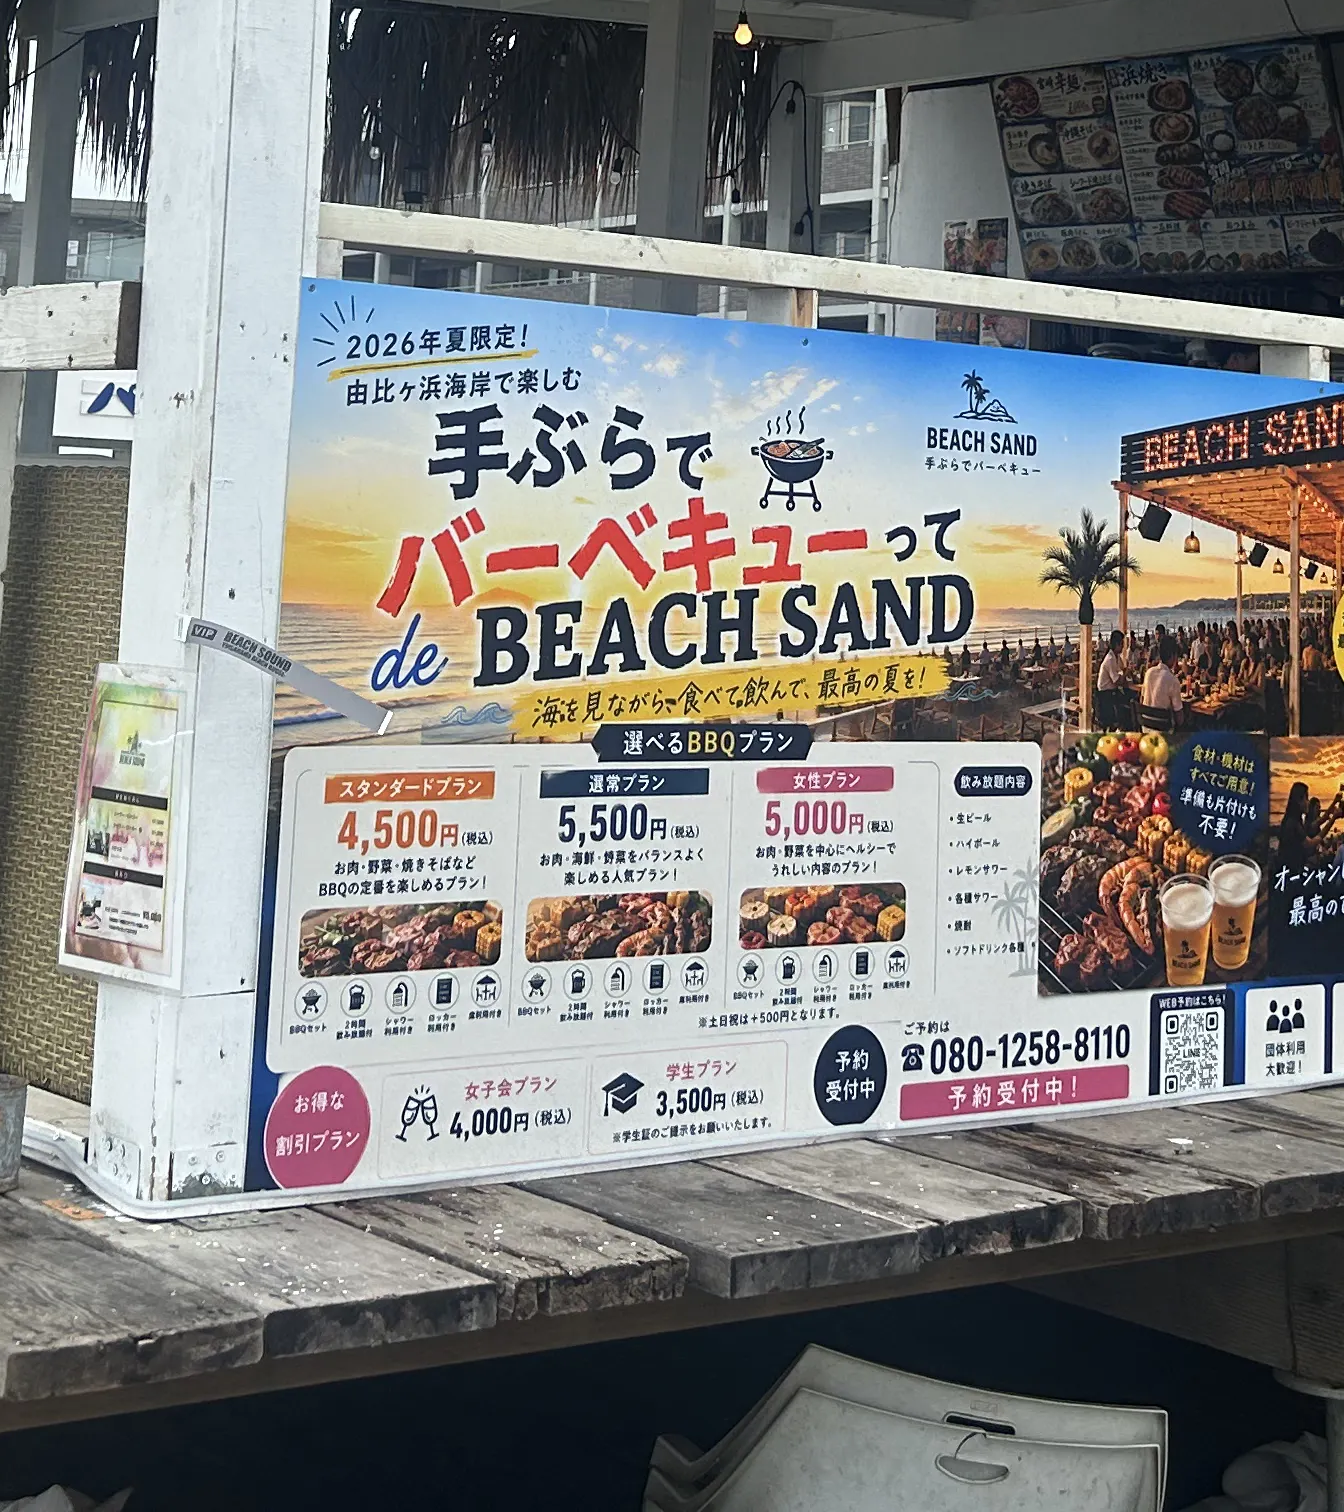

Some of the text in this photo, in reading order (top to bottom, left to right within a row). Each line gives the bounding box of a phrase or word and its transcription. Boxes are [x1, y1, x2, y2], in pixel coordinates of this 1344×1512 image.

[346, 324, 528, 359] 2026年夏限定!
[427, 401, 713, 500] 手ぶらで
[926, 426, 1038, 457] BEACH SAND
[1143, 417, 1251, 473] BEACH
[924, 455, 1042, 476] 手ぶらでバーベキュー
[194, 625, 215, 640] VIP
[370, 574, 975, 692] de BEACH SAND
[223, 630, 293, 673] BEACH SOUND
[622, 729, 795, 756] 選べるBBQプラン
[1191, 743, 1255, 774] 食材・機材は
[339, 777, 482, 800] スタンダードプラン
[793, 771, 861, 790] 女性プラン
[960, 774, 1027, 790] 飲み放題内容
[1189, 766, 1256, 797] すべてご用意!
[1179, 786, 1257, 821] 準備も片付けも
[1198, 813, 1237, 840] 不要!
[755, 842, 897, 859] お肉・野菜を中心にヘルシーで
[334, 855, 477, 876] お肉・野菜・焼きそばなど
[564, 867, 678, 886] 楽しめる人気プラン!
[771, 860, 878, 877] うれしい内容のプラン!
[318, 875, 487, 898] BBQの定番を楽しめるプラン!
[1158, 994, 1226, 1009] WEB予約はこちら!
[903, 1021, 951, 1036] ご予約は
[930, 1024, 1131, 1075] 080-1258-8110
[1182, 1048, 1201, 1059] LINE
[1265, 1040, 1306, 1058] 団体利用
[666, 1060, 738, 1082] 学生プラン
[834, 1050, 870, 1073] 予約
[1265, 1059, 1303, 1077] 大歓迎!
[464, 1076, 558, 1102] 女子会プラン
[825, 1077, 876, 1103] 受付中
[947, 1075, 1078, 1111] 予約受付中!
[294, 1090, 345, 1114] お得な
[275, 1129, 360, 1157] 割引プラン
